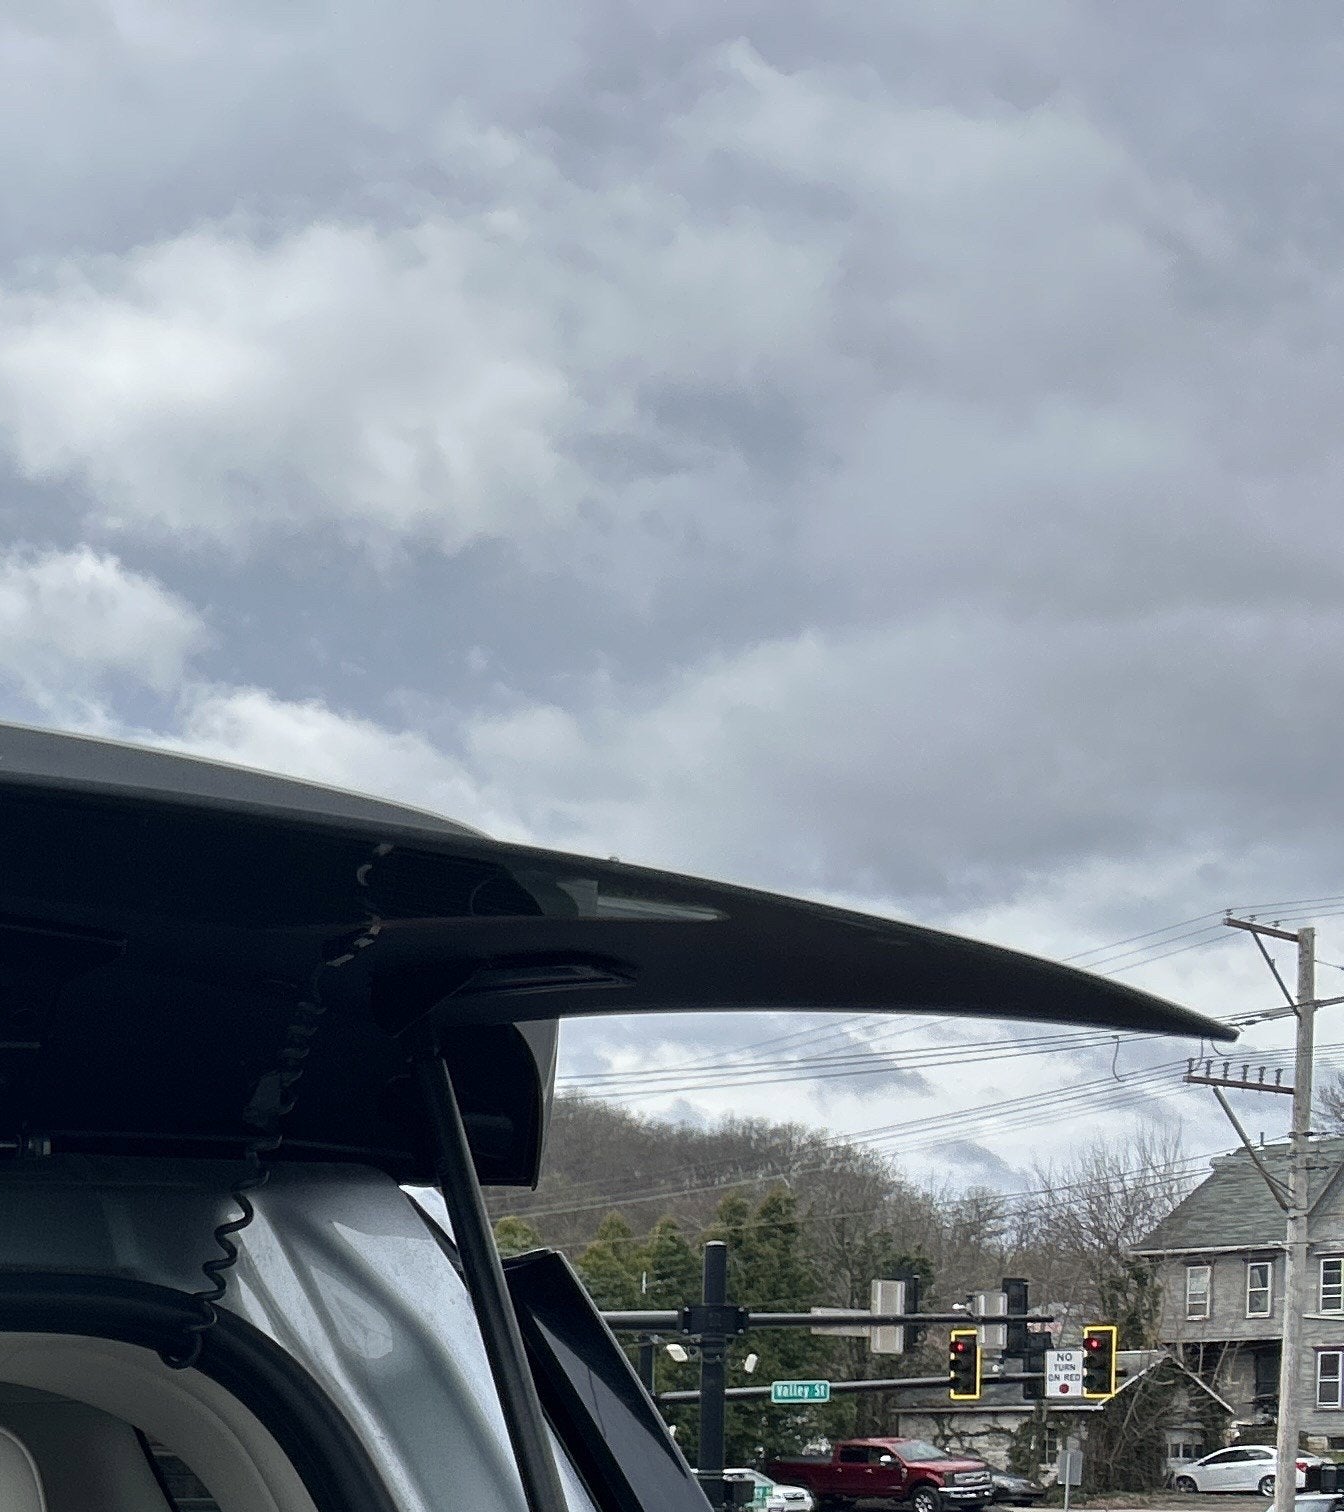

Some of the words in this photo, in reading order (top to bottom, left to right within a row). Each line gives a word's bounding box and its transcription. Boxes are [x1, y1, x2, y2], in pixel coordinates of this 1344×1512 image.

[1056, 1352, 1073, 1361] NO
[1054, 1363, 1076, 1371] TURN
[1048, 1373, 1061, 1382] ON
[1064, 1373, 1081, 1382] RED
[776, 1384, 810, 1399] Valley
[814, 1383, 826, 1397] St
